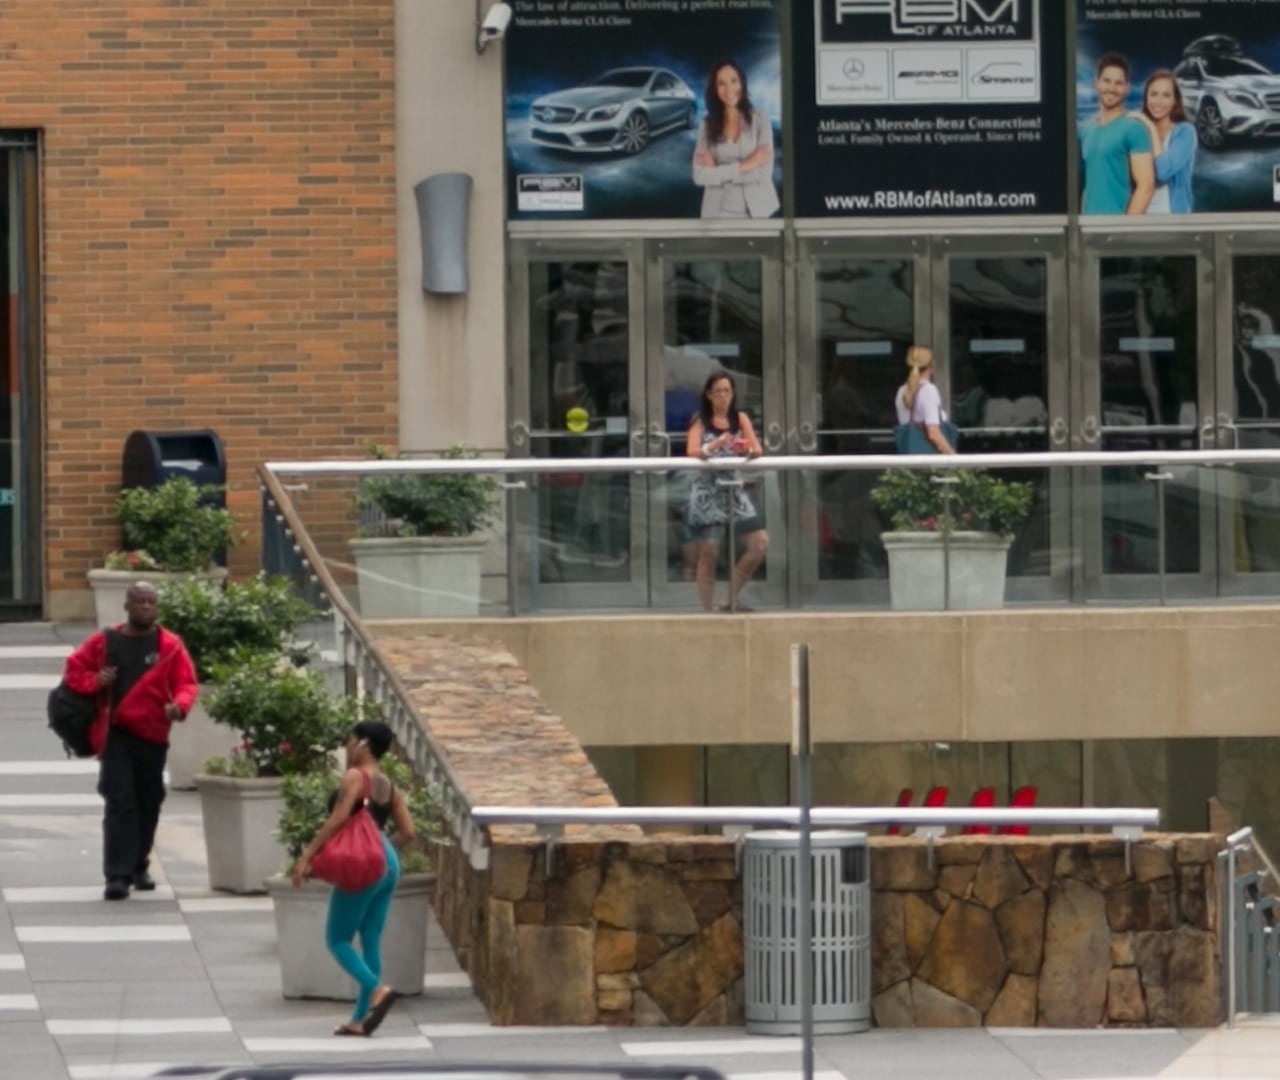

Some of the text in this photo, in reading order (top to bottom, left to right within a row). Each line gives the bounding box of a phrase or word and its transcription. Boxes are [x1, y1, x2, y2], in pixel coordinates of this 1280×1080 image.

[515, 0, 535, 12] The
[536, 0, 555, 12] law
[556, 0, 569, 11] of
[1176, 8, 1201, 19] Class
[584, 16, 605, 27] CLA
[606, 16, 632, 26] Class
[912, 24, 1017, 36] OF ATLANTA
[817, 116, 1042, 133] Atlanta's Mercedes-Benz Connection!
[850, 132, 884, 146] Family
[887, 132, 921, 144] Owned
[923, 132, 933, 143] &
[985, 131, 1014, 142] Since
[824, 190, 1037, 210] www.RBMofAtlanta.com
